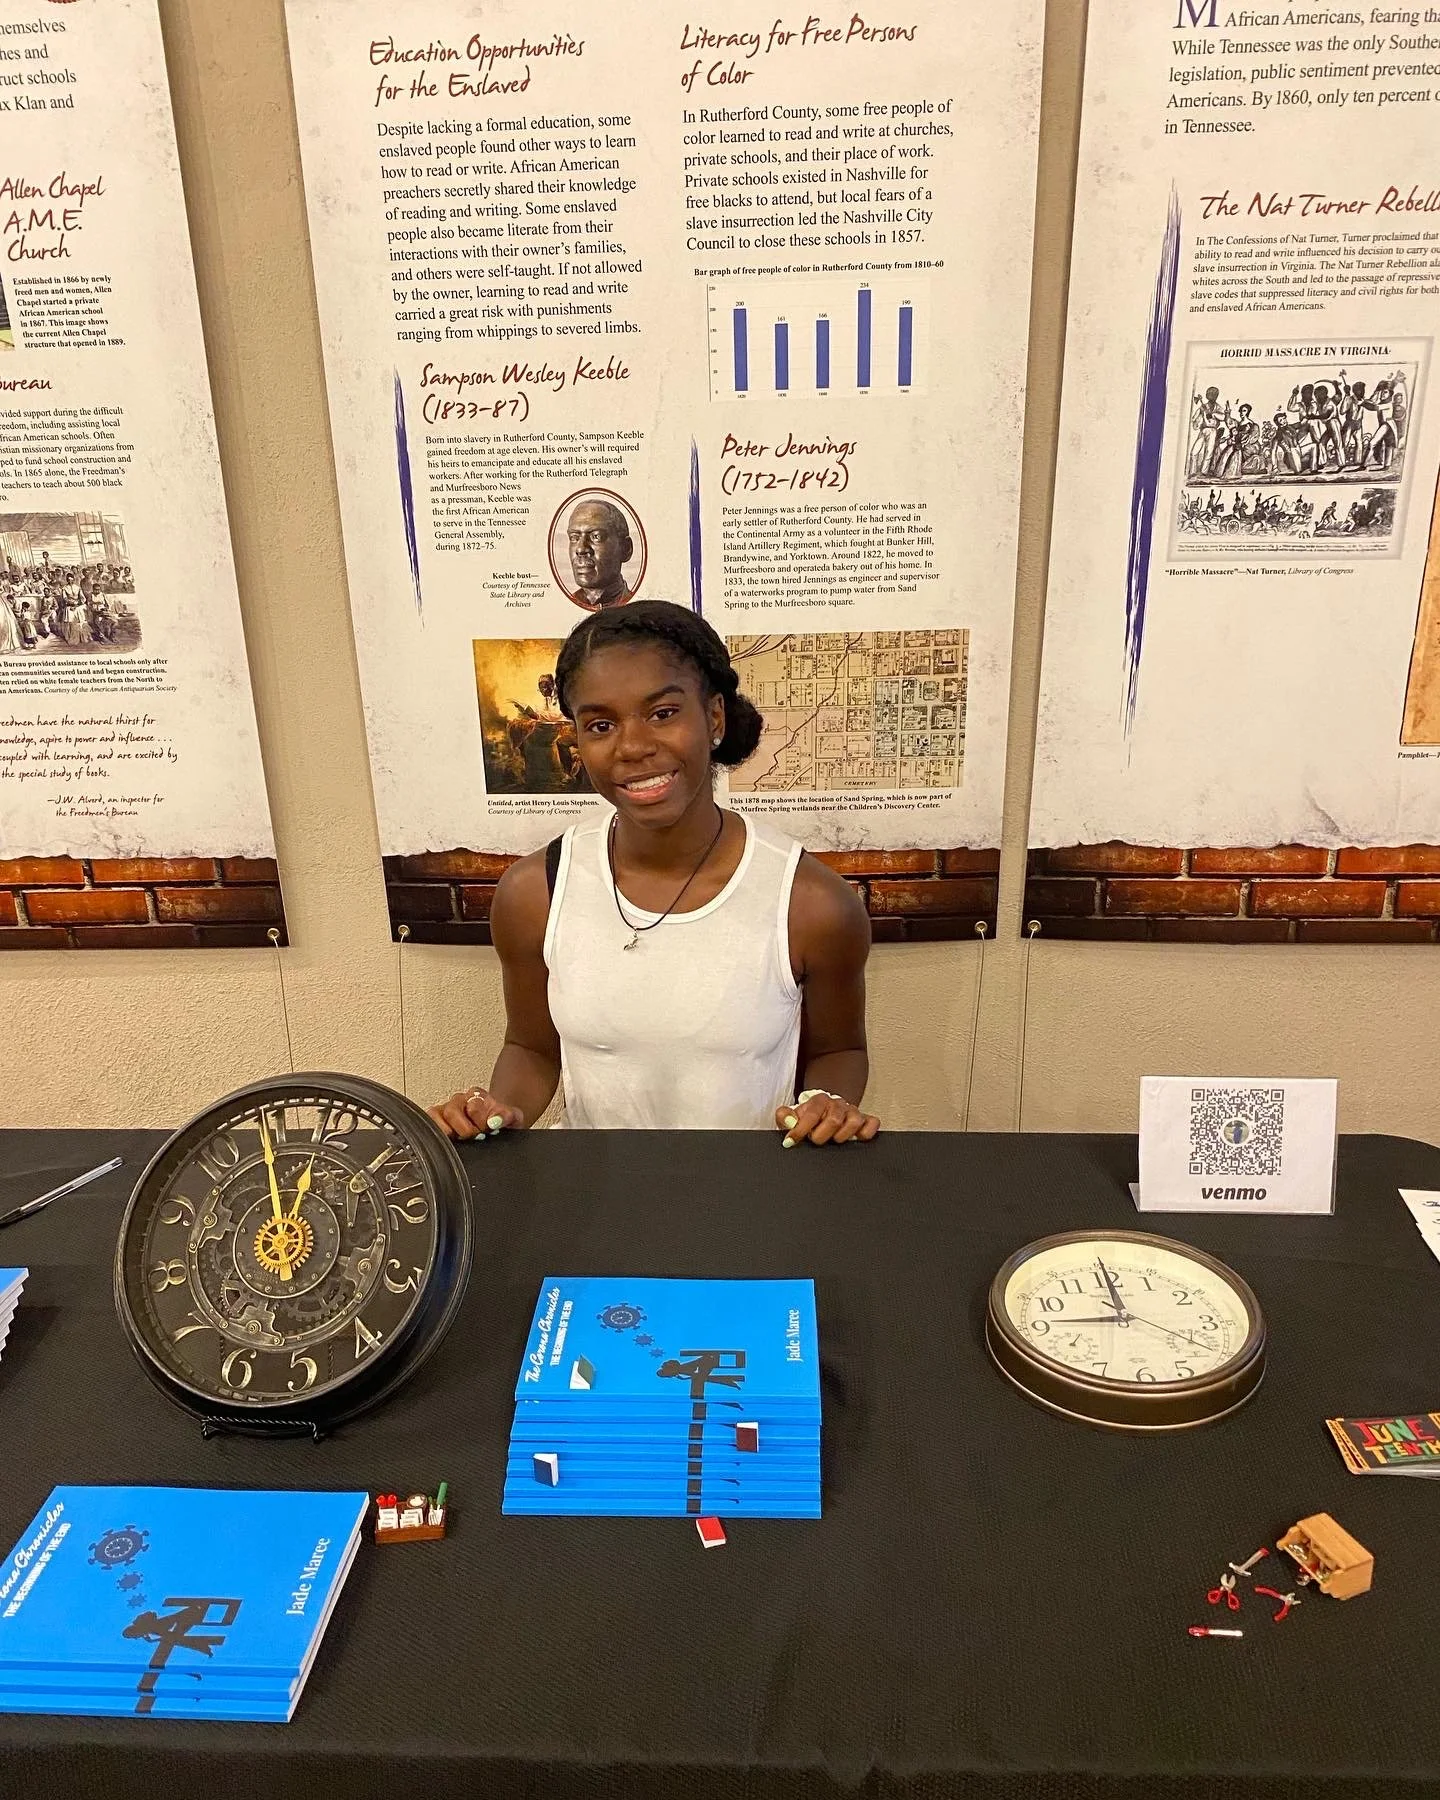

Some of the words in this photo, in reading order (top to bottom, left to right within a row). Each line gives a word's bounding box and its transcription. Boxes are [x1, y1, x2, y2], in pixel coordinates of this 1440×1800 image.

[1224, 11, 1279, 27] African
[1282, 10, 1364, 26] Americans,
[1370, 8, 1420, 27] fearing
[680, 24, 760, 59] Literacy
[765, 19, 798, 53] for
[801, 16, 843, 45] Free
[845, 13, 917, 44] Persons
[1173, 39, 1215, 55] While
[1220, 39, 1291, 54] Tennessee
[1296, 40, 1322, 51] was
[1328, 36, 1349, 50] the
[1353, 35, 1385, 54] only
[25, 43, 49, 59] and
[370, 36, 462, 65] Education
[466, 33, 585, 71] Opportunities
[27, 69, 76, 84] schools
[681, 60, 702, 93] of
[707, 61, 755, 86] Color
[1169, 65, 1247, 86] legislation,
[1250, 63, 1295, 84] public
[1299, 62, 1369, 78] sentiment
[375, 74, 404, 107] for
[410, 70, 438, 99] the
[448, 65, 531, 97] Enslaved
[14, 96, 47, 110] Klan
[50, 94, 74, 108] and
[1166, 92, 1246, 108] Americans.
[1251, 91, 1273, 109] By
[1276, 90, 1312, 107] 1860,
[1317, 89, 1349, 107] only
[1353, 90, 1374, 103] ten
[1377, 88, 1431, 106] percent
[683, 110, 696, 123] In
[700, 106, 768, 122] Rutherford
[772, 106, 821, 121] County,
[826, 106, 859, 117] some
[863, 102, 887, 115] free
[890, 100, 934, 118] people
[938, 99, 953, 113] of
[377, 123, 424, 139] Despite
[427, 120, 472, 136] lacking
[476, 123, 483, 132] a
[487, 117, 527, 131] formal
[531, 114, 594, 130] education,
[598, 116, 631, 127] some
[1165, 119, 1177, 134] in
[1182, 119, 1255, 133] Tennessee.
[0, 177, 45, 200] Allen
[49, 171, 104, 207] Chapel
[1200, 190, 1239, 219] The
[1247, 192, 1296, 217] Nat
[1299, 194, 1371, 217] Turner
[3, 209, 82, 234] A.M.E.
[8, 233, 71, 262] Church
[709, 268, 730, 277] graph
[758, 266, 781, 275] people
[822, 263, 863, 271] Rutherford
[866, 263, 891, 271] County
[1221, 348, 1261, 357] HORRID
[1265, 347, 1321, 357] MASSACRE
[1324, 347, 1336, 356] IN
[420, 363, 495, 395] Sampson
[502, 363, 565, 392] Wesley
[573, 355, 629, 385] Keeble
[426, 435, 444, 445] Born
[446, 434, 463, 443] into
[463, 433, 491, 447] slavery
[493, 434, 501, 443] in
[503, 433, 545, 445] Rutherford
[547, 432, 579, 444] County,
[579, 432, 615, 442] Sampson
[617, 430, 644, 440] Keeble
[721, 433, 770, 459] Peter
[775, 433, 857, 464] Jennings
[1288, 568, 1315, 576] Library
[1315, 567, 1323, 576] of
[1323, 567, 1354, 575] Congress
[2, 767, 16, 778] the
[18, 768, 47, 783] special
[50, 765, 72, 782] study
[75, 767, 84, 780] of
[86, 765, 110, 777] books.
[120, 795, 151, 806] inspector
[153, 794, 165, 805] for
[488, 799, 513, 808] Untitled,
[532, 799, 551, 808] Henry
[571, 799, 601, 807] Stephens.
[311, 1107, 359, 1151] 12
[193, 1134, 240, 1182] 10
[1201, 1187, 1267, 1200] venmo
[159, 1199, 196, 1227] 9
[387, 1197, 430, 1231] 2
[150, 1259, 187, 1293] 8
[384, 1259, 424, 1294] 3
[1057, 1279, 1087, 1295] 11
[1090, 1271, 1123, 1289] 12
[1137, 1276, 1156, 1291] 1
[538, 1287, 560, 1332] Chronicles
[1035, 1296, 1064, 1312] 10
[1172, 1291, 1193, 1306] 2
[786, 1309, 800, 1338] Maree
[1031, 1320, 1051, 1337] 9
[1199, 1315, 1219, 1331] 3
[354, 1316, 383, 1359] 4
[530, 1333, 549, 1365] Corona
[785, 1340, 804, 1362] Jade
[222, 1348, 257, 1389] 6
[287, 1348, 318, 1392] 5
[525, 1366, 541, 1382] The
[1136, 1367, 1156, 1382] 6
[1174, 1360, 1195, 1378] 5
[1350, 1417, 1435, 1447] JUNE
[14, 1502, 64, 1568] Chronicles
[55, 1523, 71, 1538] END
[45, 1537, 63, 1551] THE
[39, 1551, 52, 1562] OF
[13, 1561, 46, 1601] BEGINNING
[286, 1583, 312, 1616] Jade
[300, 1537, 331, 1579] Maree
[3, 1601, 21, 1618] THE
